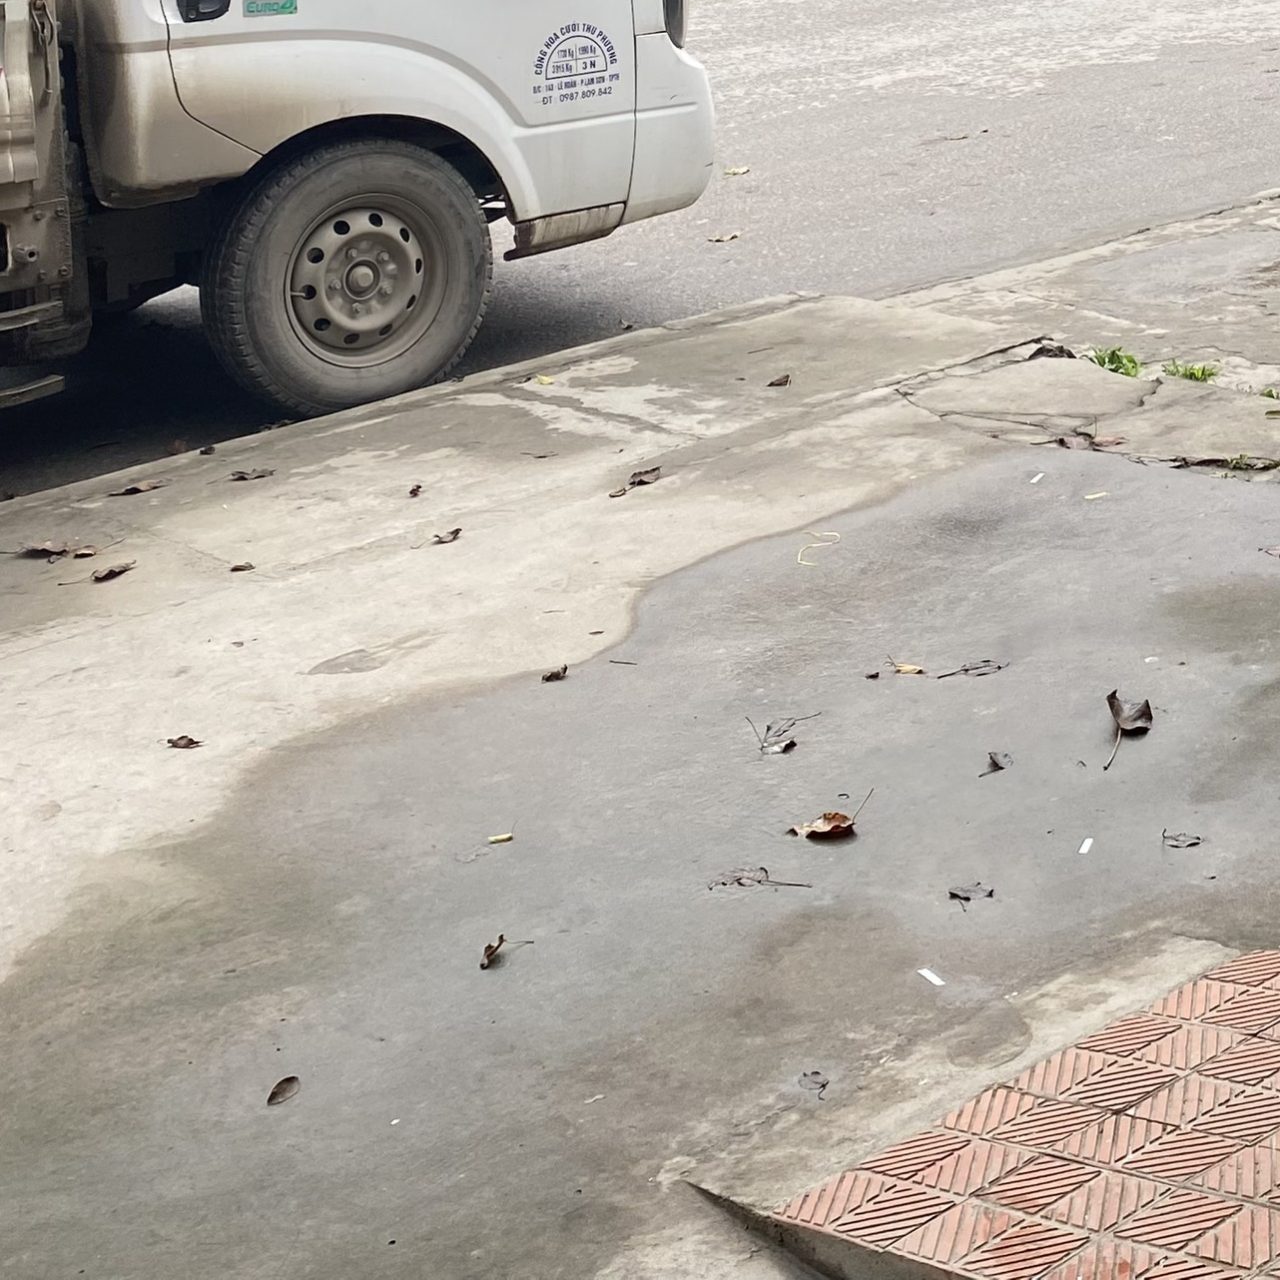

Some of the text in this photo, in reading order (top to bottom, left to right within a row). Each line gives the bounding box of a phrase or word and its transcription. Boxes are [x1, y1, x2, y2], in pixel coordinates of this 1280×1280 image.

[582, 23, 597, 36] THU
[582, 61, 588, 70] 3
[590, 60, 596, 69] N
